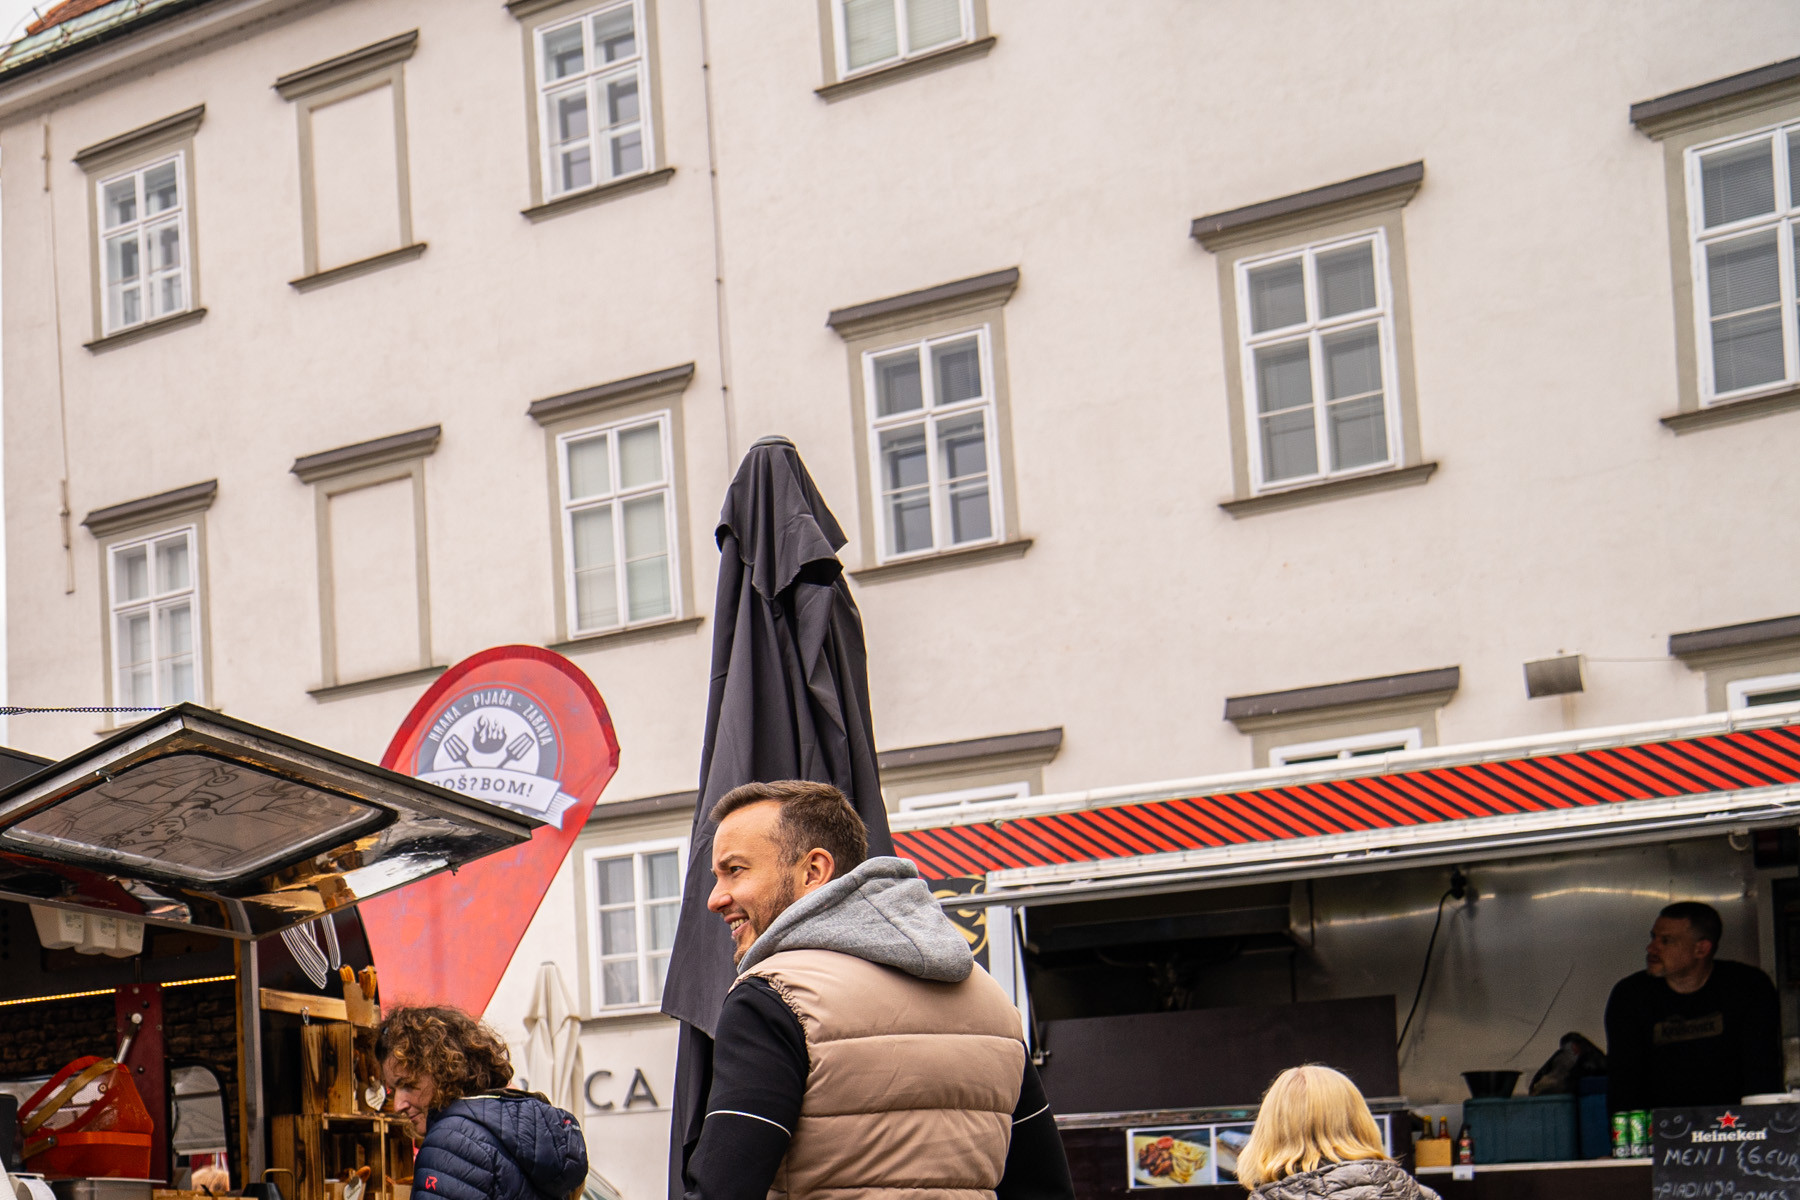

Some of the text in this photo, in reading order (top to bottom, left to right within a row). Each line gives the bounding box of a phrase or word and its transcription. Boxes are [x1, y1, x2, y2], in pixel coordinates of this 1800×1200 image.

[428, 688, 554, 746] HRANA PIJAČA ZABAVA
[1691, 1128, 1768, 1144] Heineken
